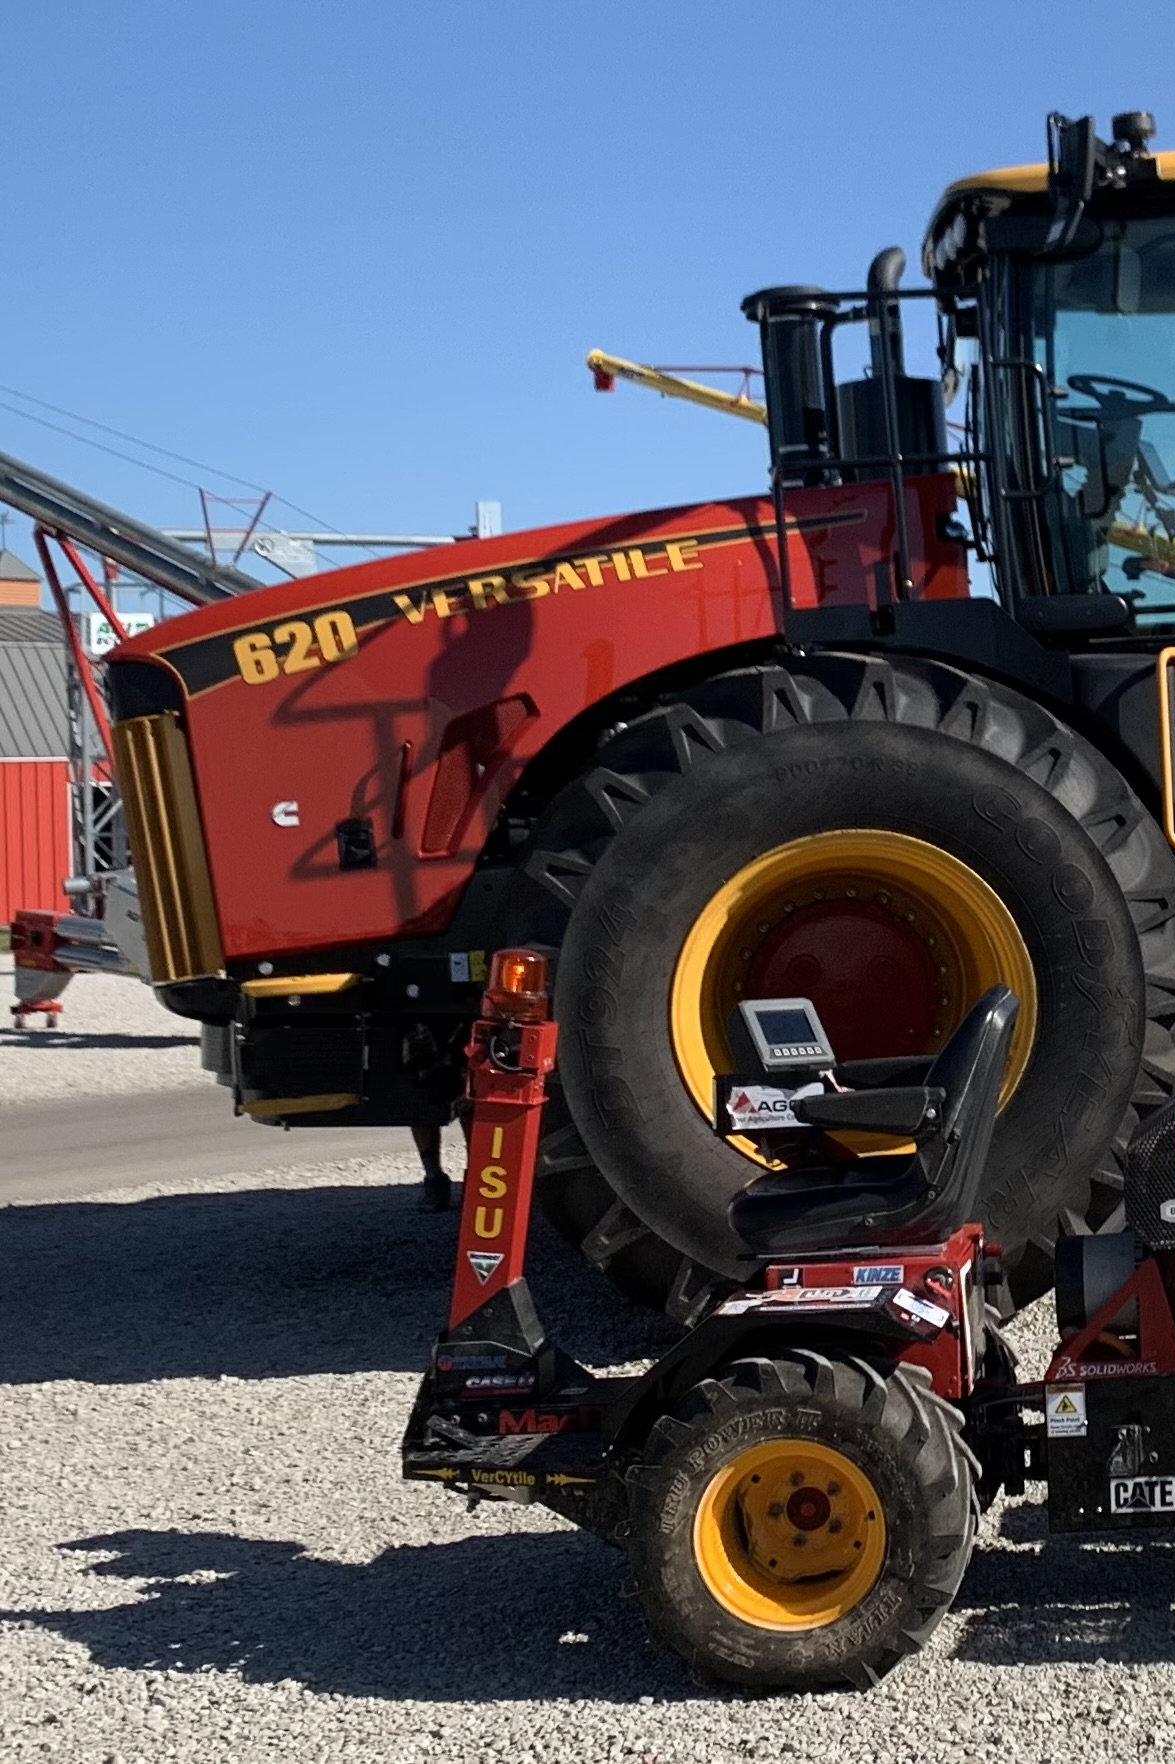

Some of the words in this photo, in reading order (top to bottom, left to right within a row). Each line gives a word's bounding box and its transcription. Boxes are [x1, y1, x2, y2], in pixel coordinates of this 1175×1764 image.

[392, 538, 704, 625] VERSATILE
[232, 609, 358, 686] 620
[757, 1099, 797, 1113] AG
[855, 1267, 901, 1283] KINZE
[1080, 1361, 1157, 1377] SOLIDWORKS
[465, 1375, 517, 1388] CASE
[1066, 1416, 1081, 1424] Point
[471, 1468, 536, 1486] VerCYtile
